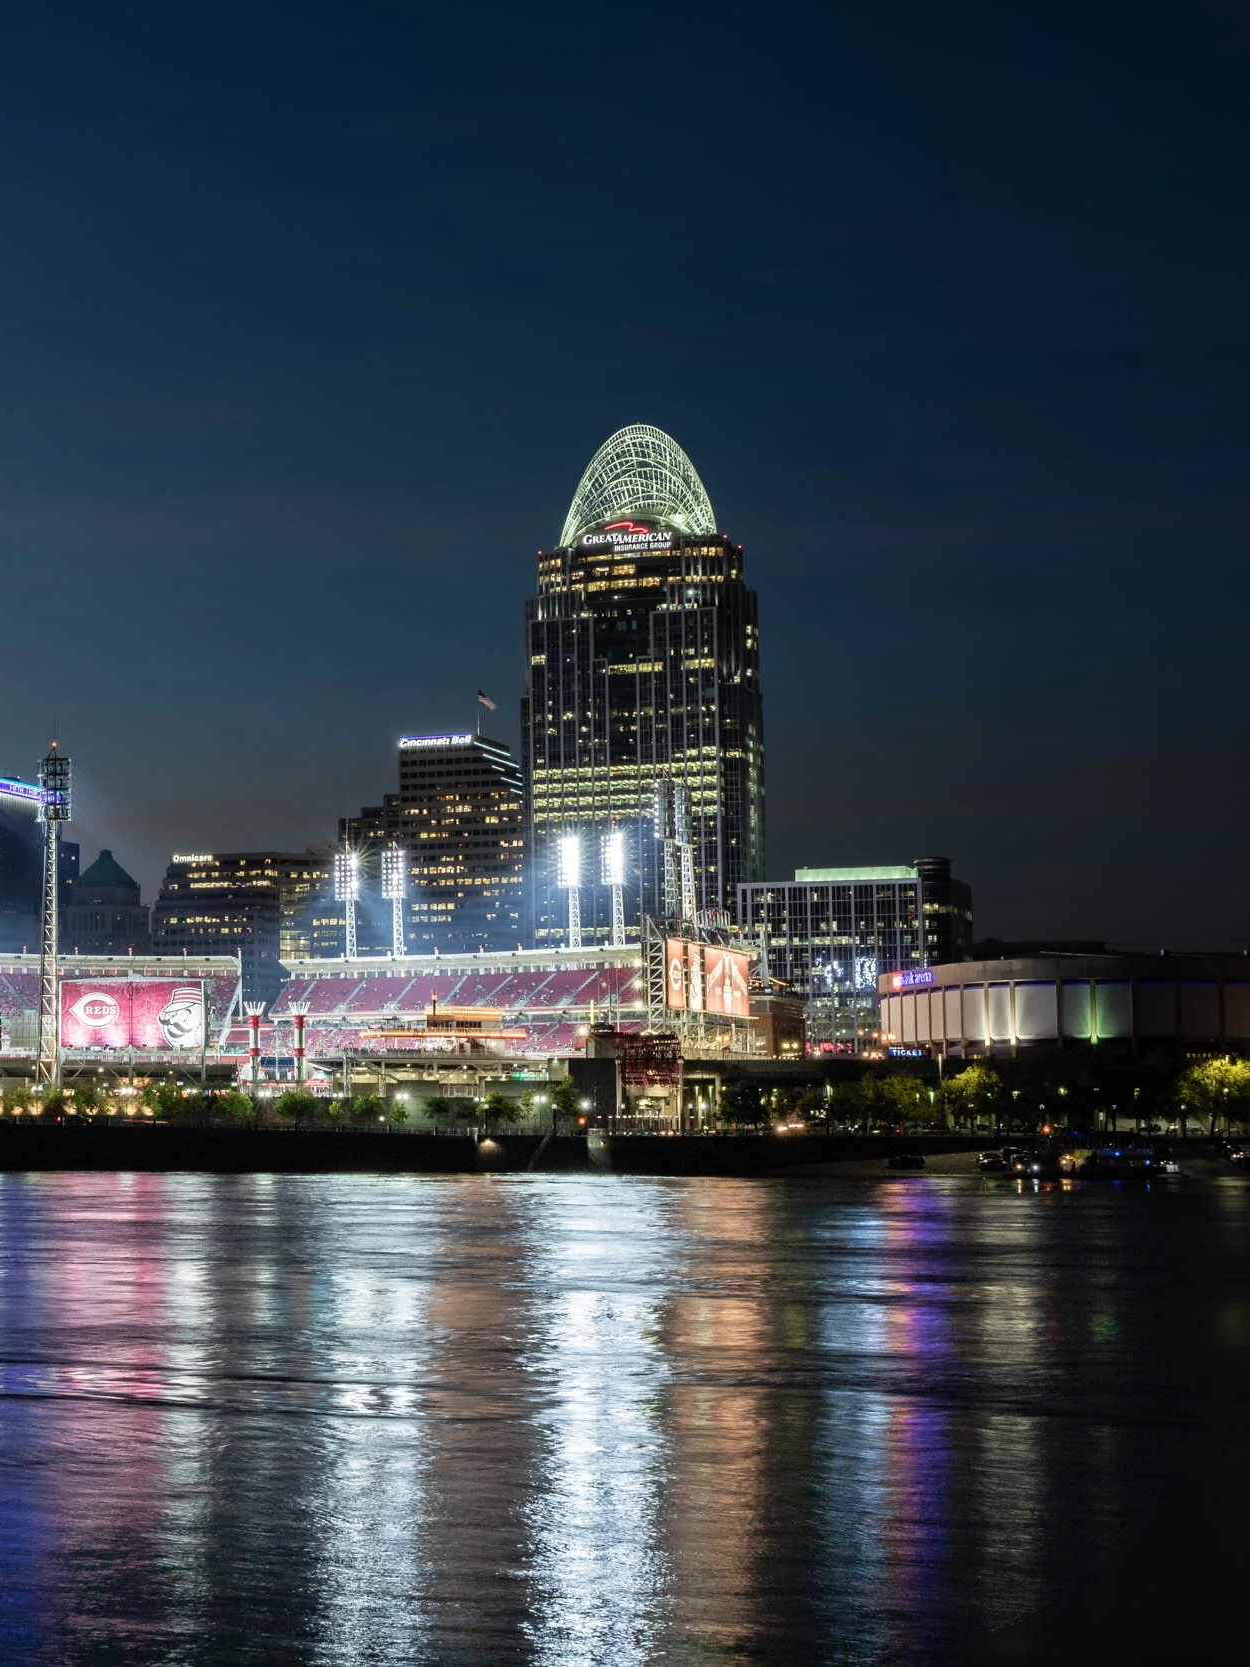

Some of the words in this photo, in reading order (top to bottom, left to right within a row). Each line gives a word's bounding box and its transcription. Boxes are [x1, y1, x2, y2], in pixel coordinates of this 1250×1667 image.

[614, 543, 648, 552] INSURANCE
[649, 541, 671, 549] GROUP
[399, 737, 450, 748] Cincinnati
[173, 854, 213, 863] Omnicare
[85, 1005, 117, 1015] REDS
